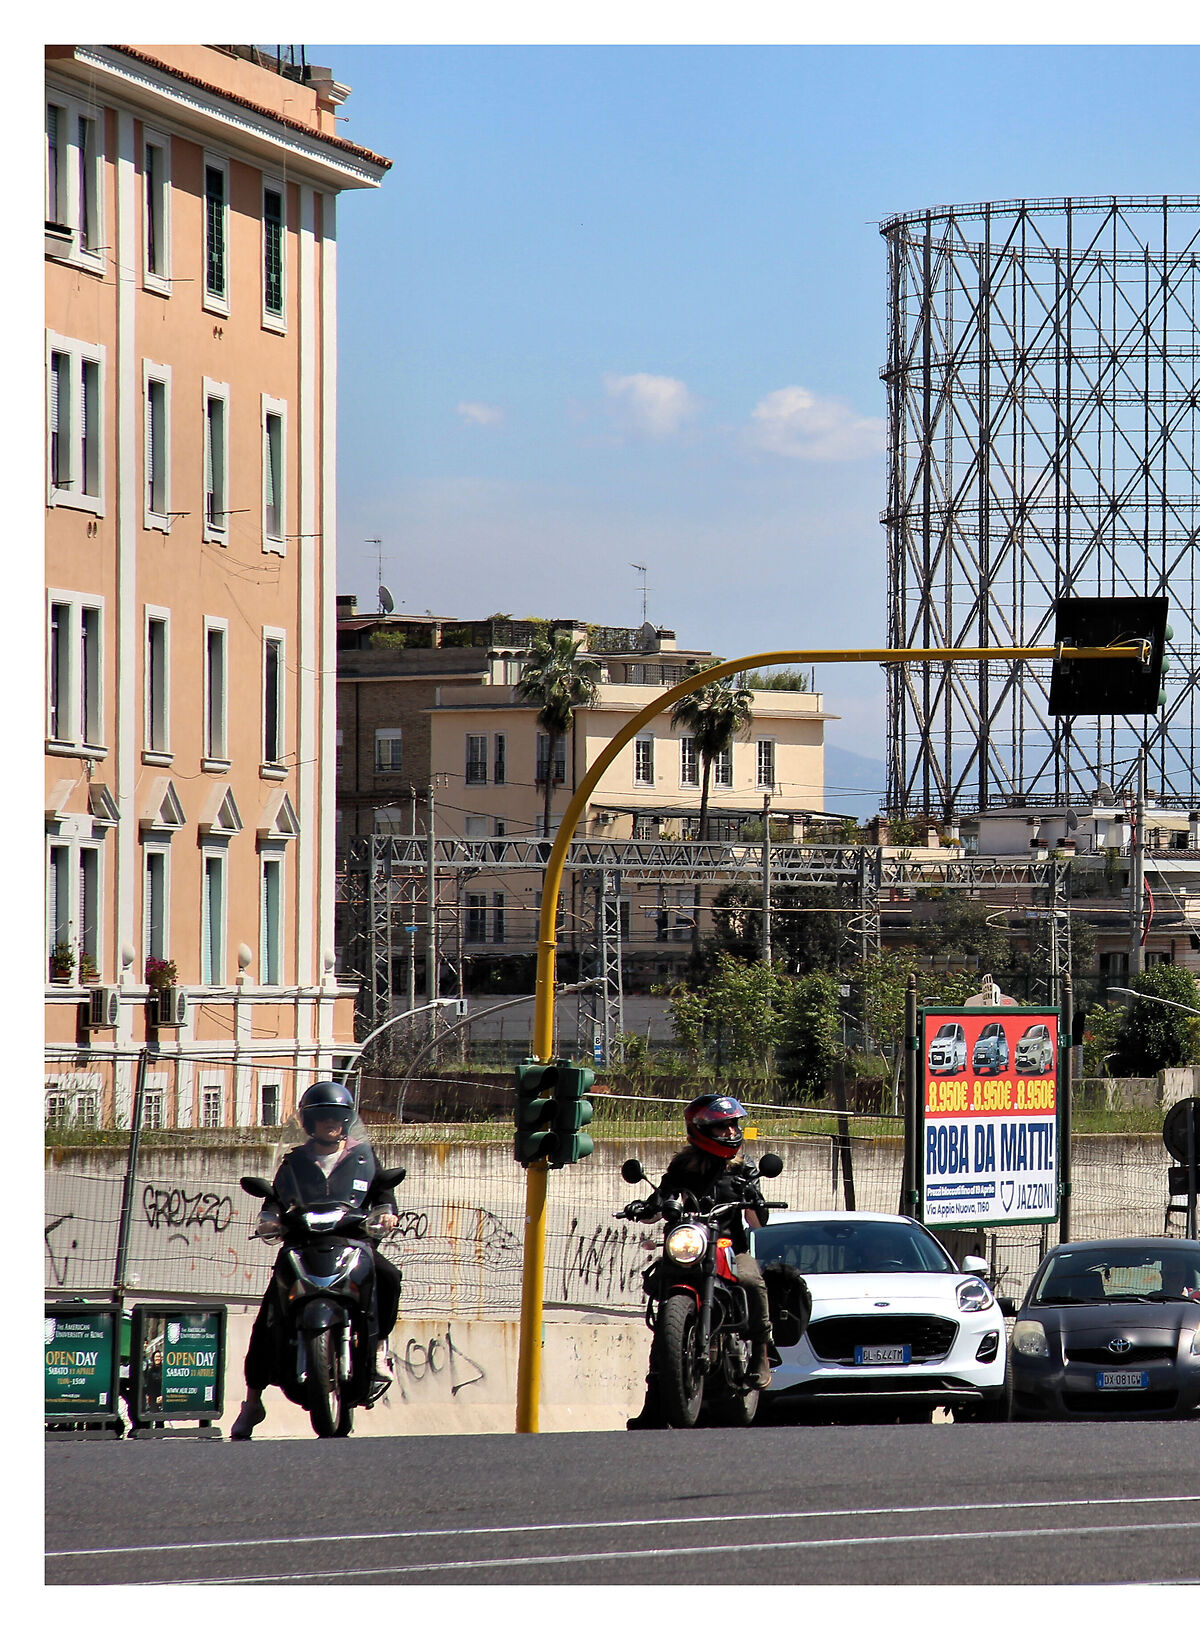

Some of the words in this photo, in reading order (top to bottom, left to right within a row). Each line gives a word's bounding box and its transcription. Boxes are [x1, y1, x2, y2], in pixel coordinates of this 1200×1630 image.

[929, 1081, 968, 1112] 8.950€
[973, 1080, 1012, 1111] 8.950€
[1017, 1080, 1055, 1110] 8.950€
[926, 1125, 969, 1175] ROBA
[974, 1123, 996, 1173] DA
[1000, 1122, 1053, 1171] MATTI!
[926, 1203, 936, 1215] Via
[937, 1203, 955, 1218] Appia
[956, 1203, 976, 1215] Nuova,
[977, 1201, 990, 1213] 1160
[1016, 1183, 1053, 1210] JAZZONI
[48, 1366, 69, 1375] SABATO
[166, 1368, 190, 1377] SABATO
[1104, 1375, 1114, 1385] DX
